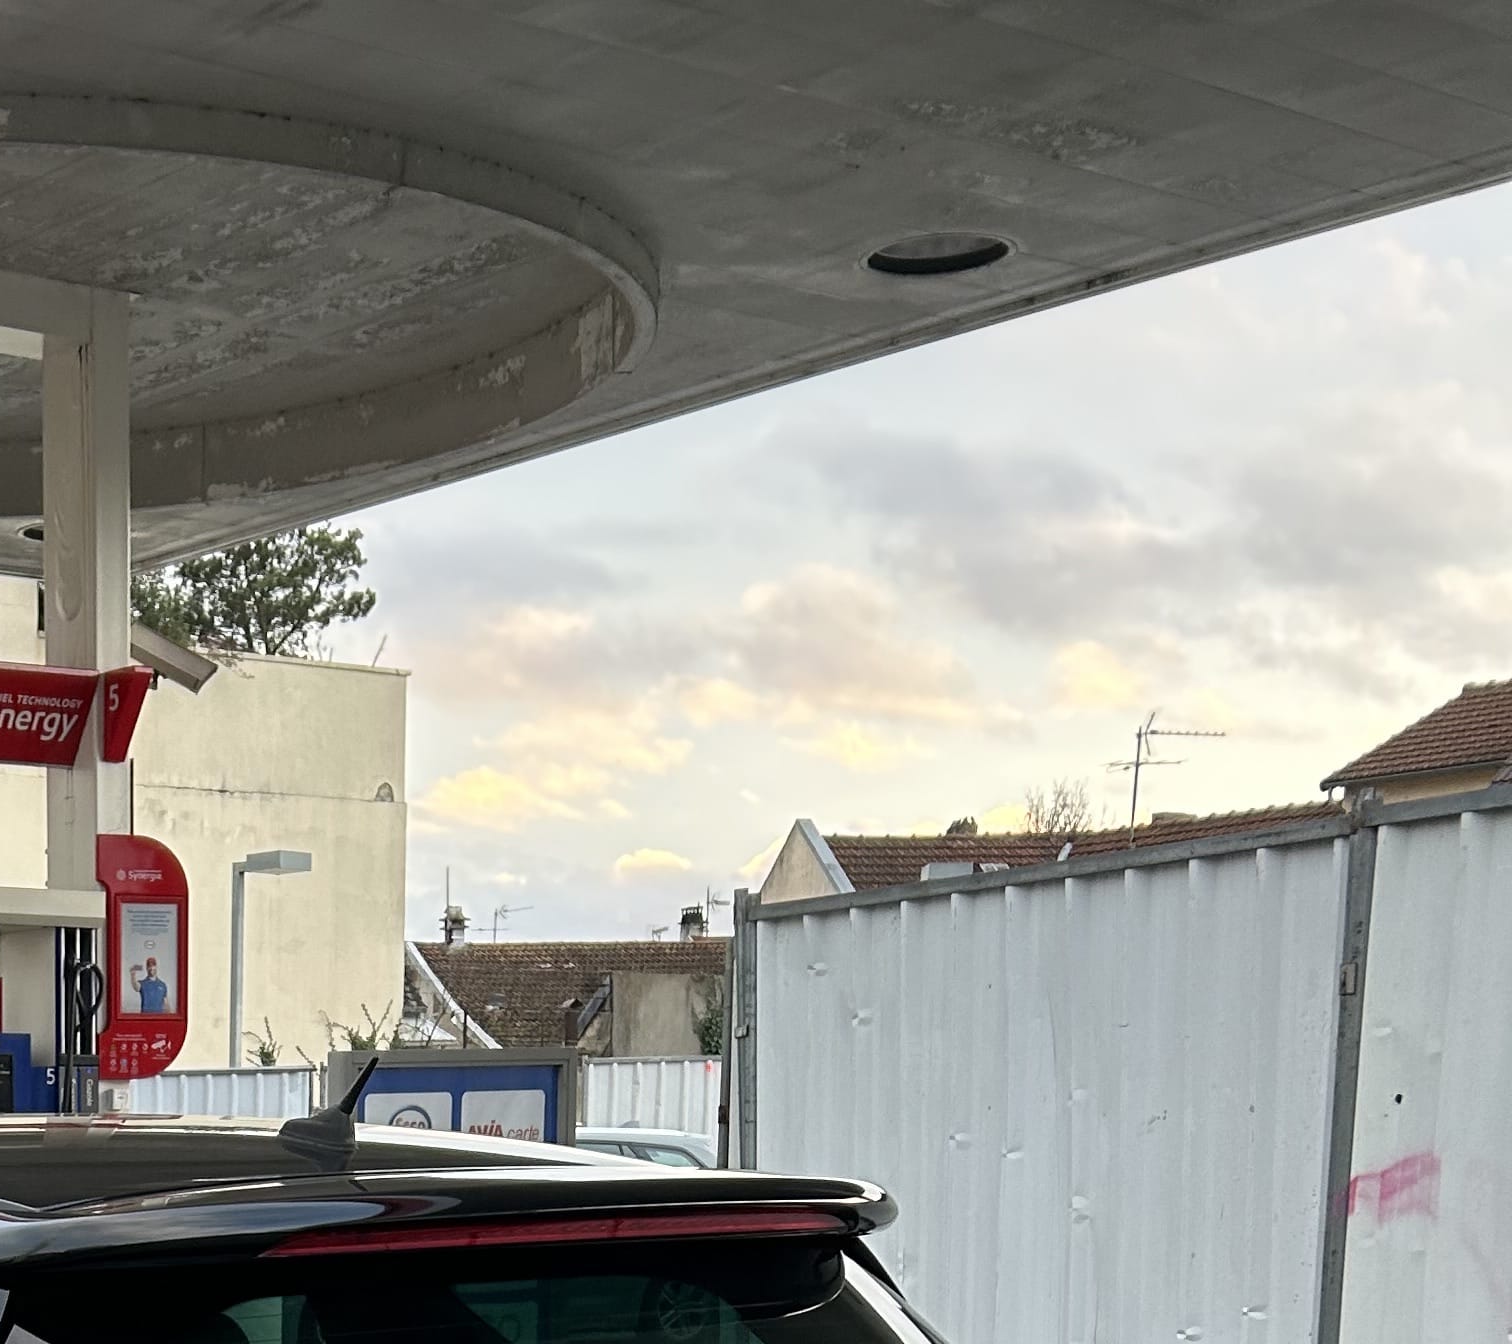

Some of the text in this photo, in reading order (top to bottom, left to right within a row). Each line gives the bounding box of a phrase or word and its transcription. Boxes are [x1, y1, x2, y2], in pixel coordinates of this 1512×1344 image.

[17, 694, 84, 709] TECHNOLOGY
[109, 684, 119, 711] 5
[46, 1068, 56, 1085] 5
